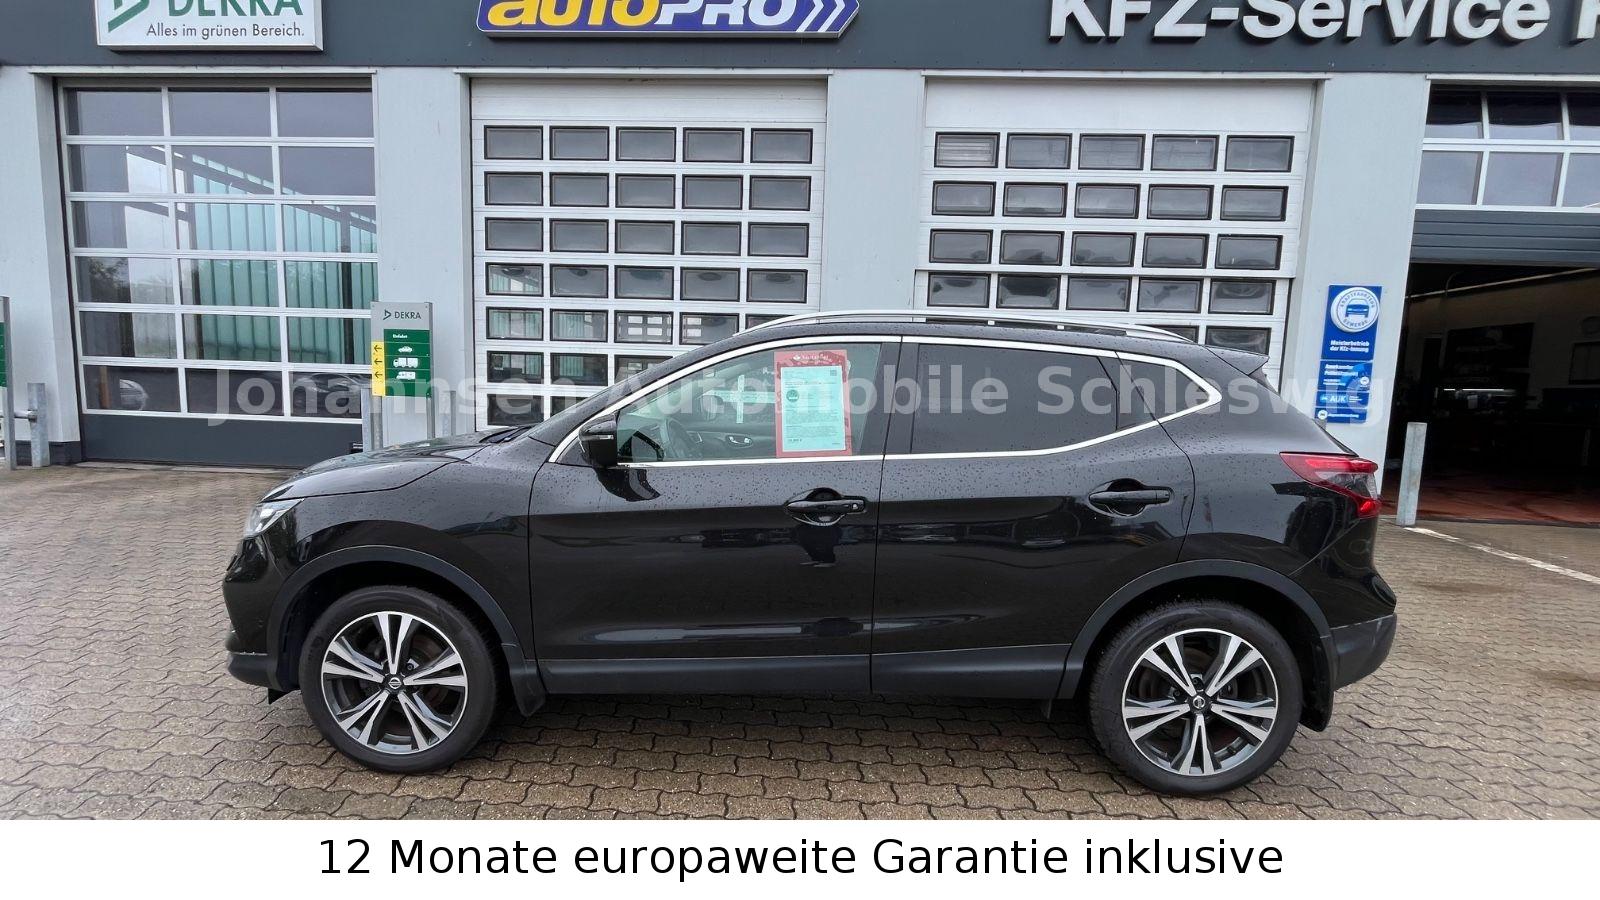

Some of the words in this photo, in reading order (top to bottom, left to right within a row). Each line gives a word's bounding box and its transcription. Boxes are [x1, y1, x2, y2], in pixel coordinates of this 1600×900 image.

[146, 22, 178, 36] Alles
[182, 23, 197, 36] im
[201, 24, 247, 40] grünen
[252, 22, 304, 37] Bereich.
[394, 311, 421, 319] DEKRA
